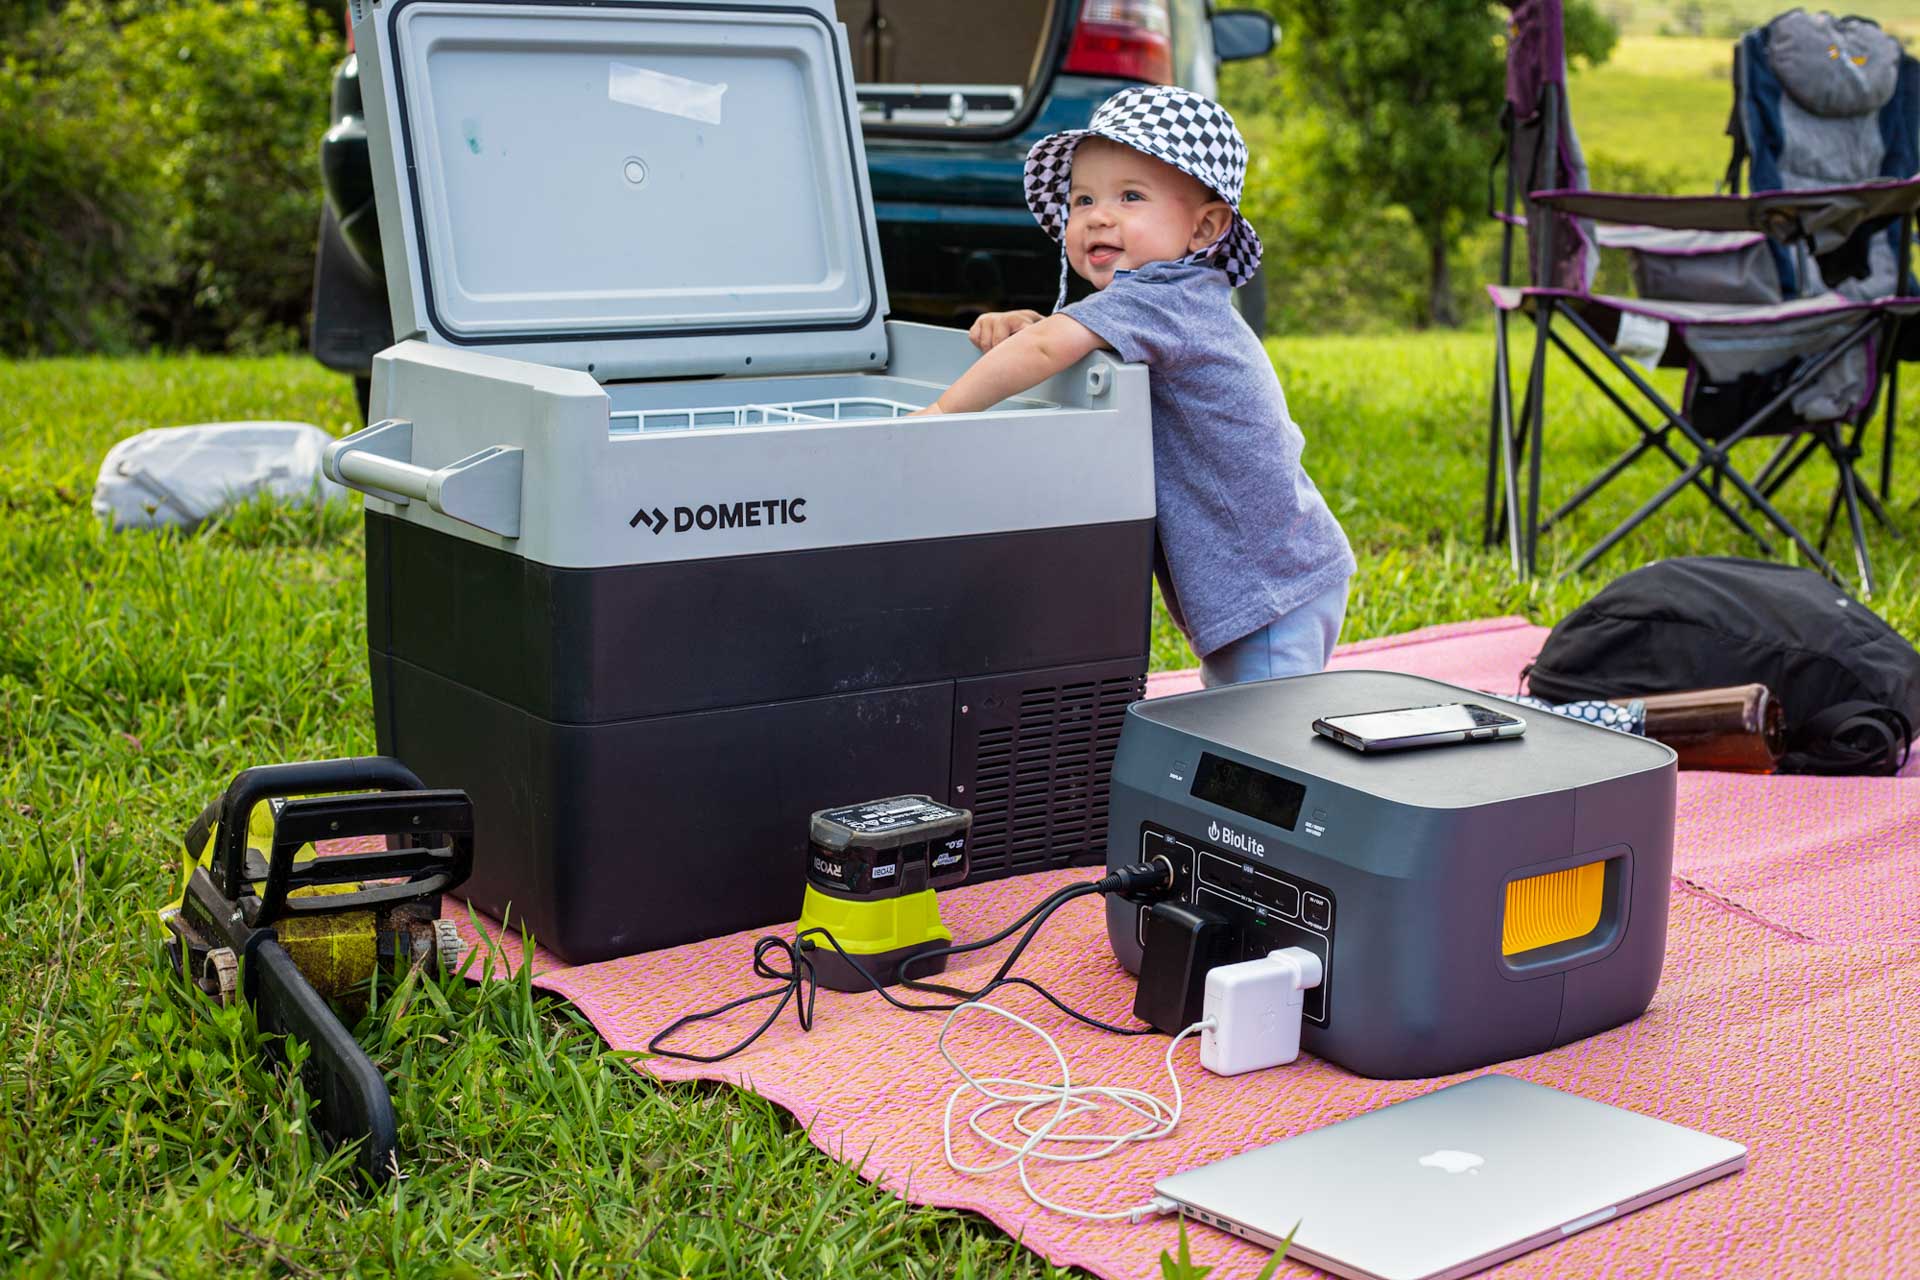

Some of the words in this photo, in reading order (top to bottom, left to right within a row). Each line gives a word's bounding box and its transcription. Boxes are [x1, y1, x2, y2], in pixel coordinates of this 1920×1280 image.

[674, 497, 807, 533] DOMETIC
[1222, 826, 1265, 857] BioLite
[813, 856, 843, 878] RYOBI
[873, 865, 894, 878] RYOBI
